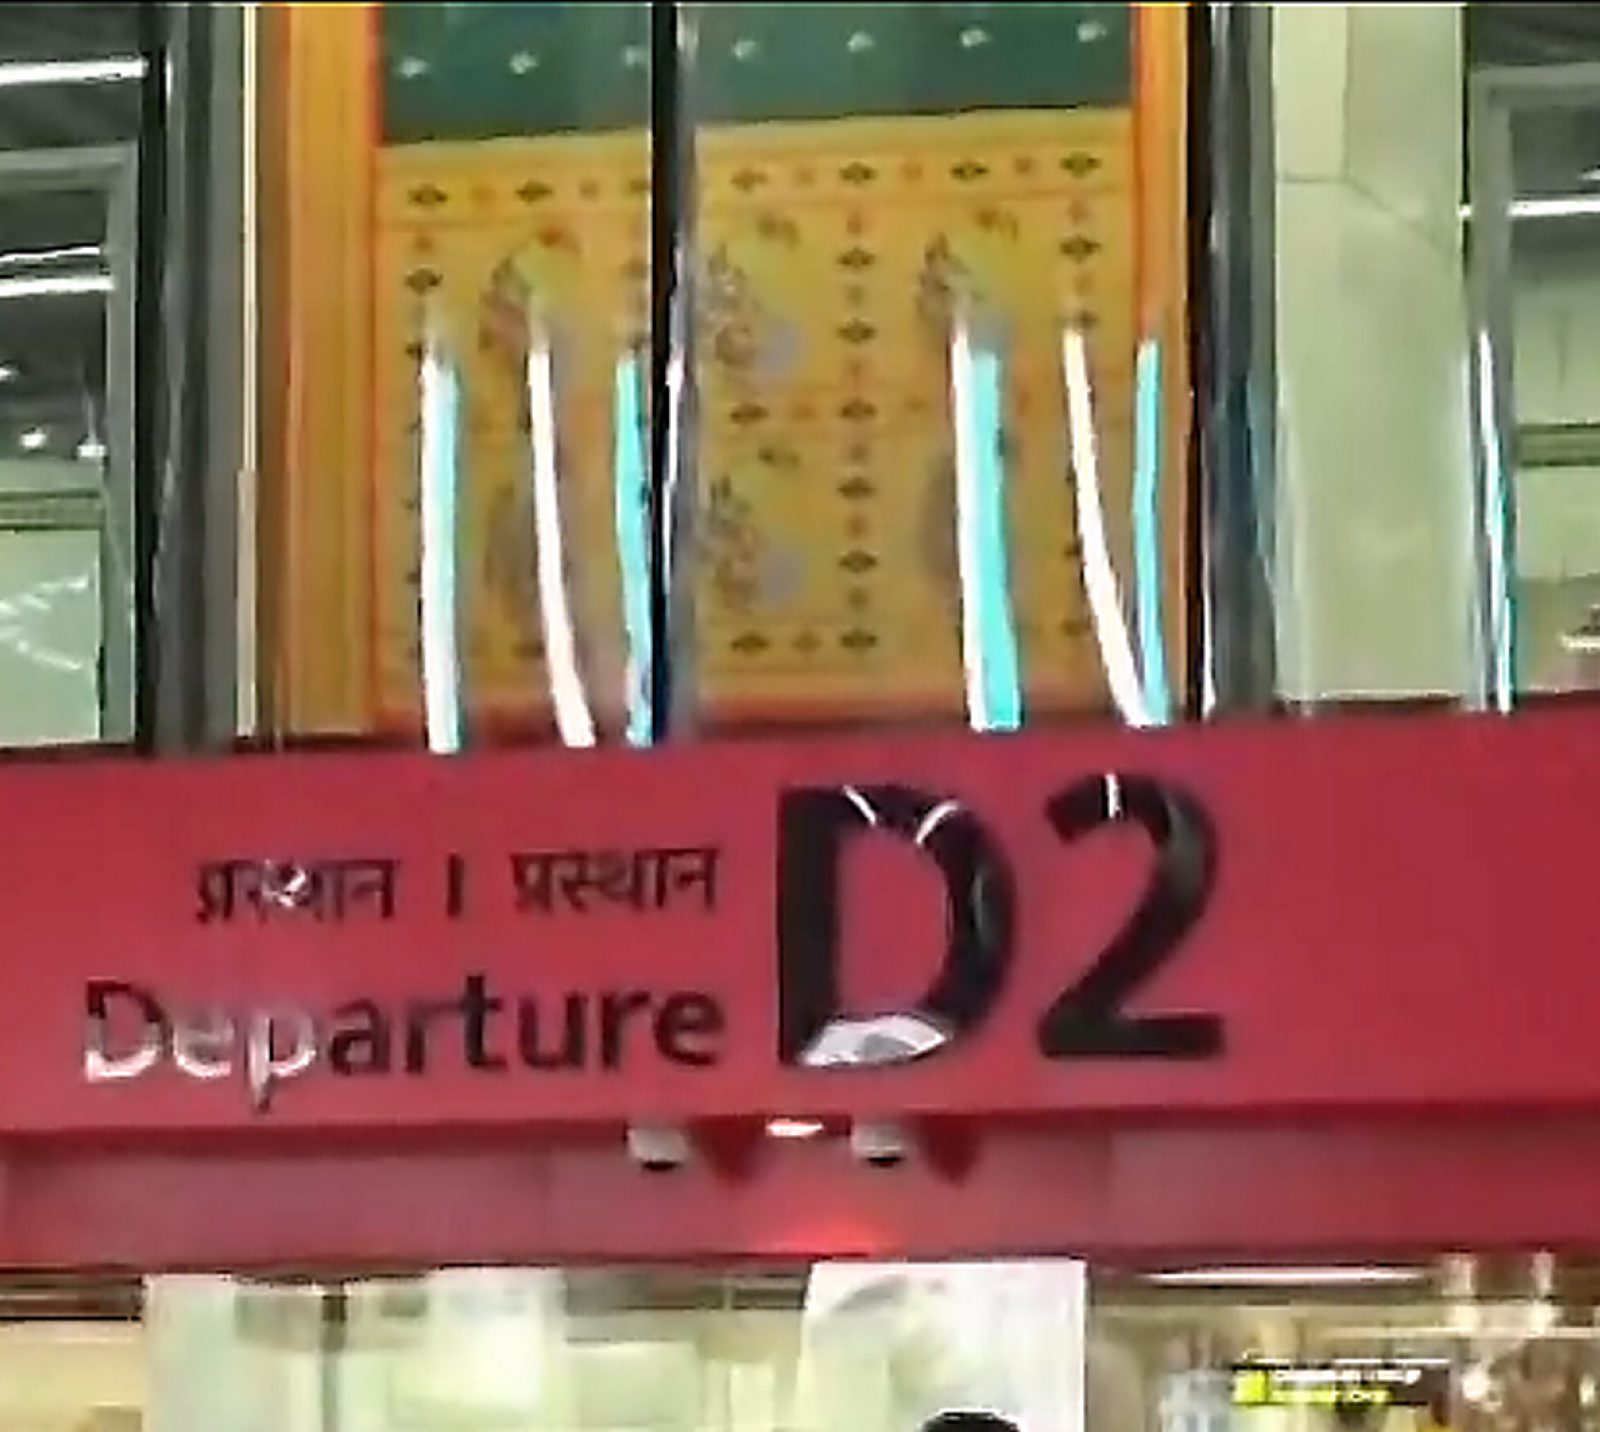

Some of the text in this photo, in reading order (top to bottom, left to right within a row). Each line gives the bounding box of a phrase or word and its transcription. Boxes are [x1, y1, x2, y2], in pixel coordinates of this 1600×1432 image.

[509, 845, 720, 916] प्रस्थान
[778, 773, 1226, 1068] D2
[84, 974, 724, 1113] Departure
